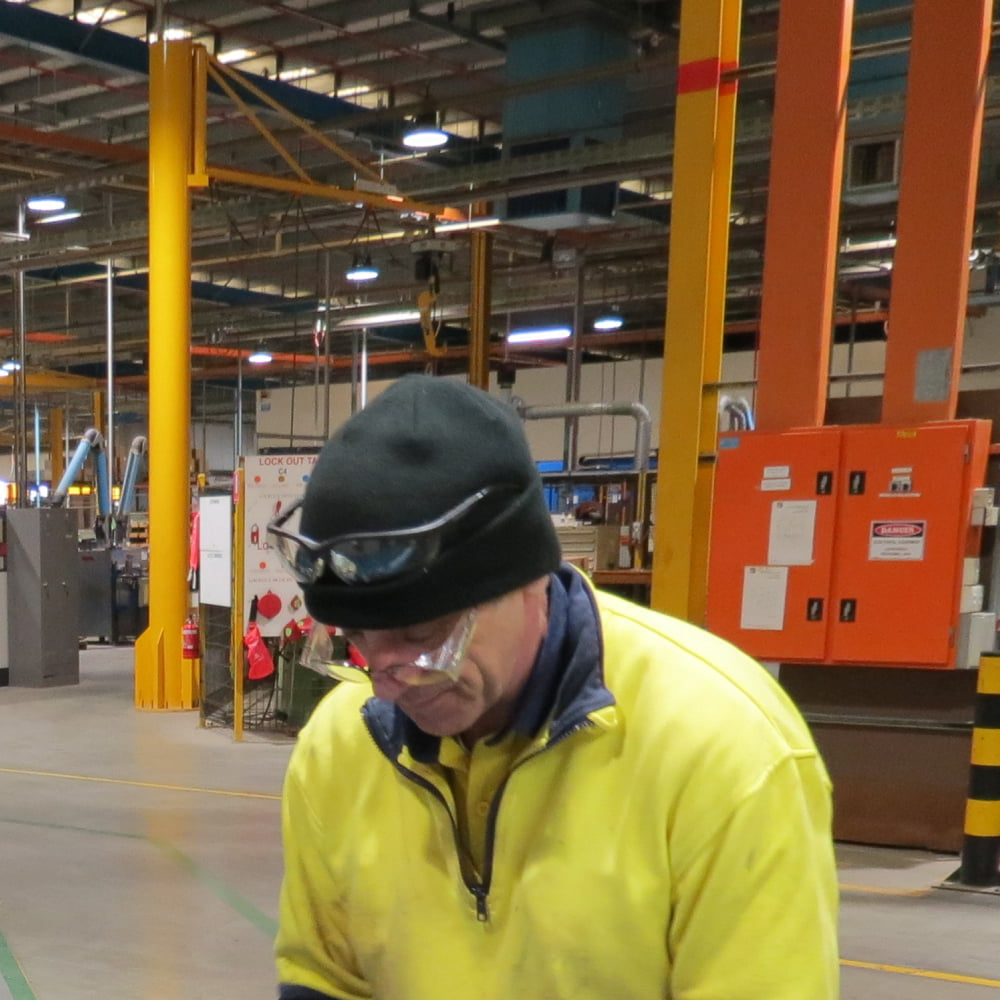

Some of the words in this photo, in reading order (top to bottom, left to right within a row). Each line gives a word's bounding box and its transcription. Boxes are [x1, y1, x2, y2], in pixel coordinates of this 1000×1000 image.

[259, 457, 283, 466] LOCK
[286, 457, 304, 465] OUT
[307, 456, 318, 465] TA
